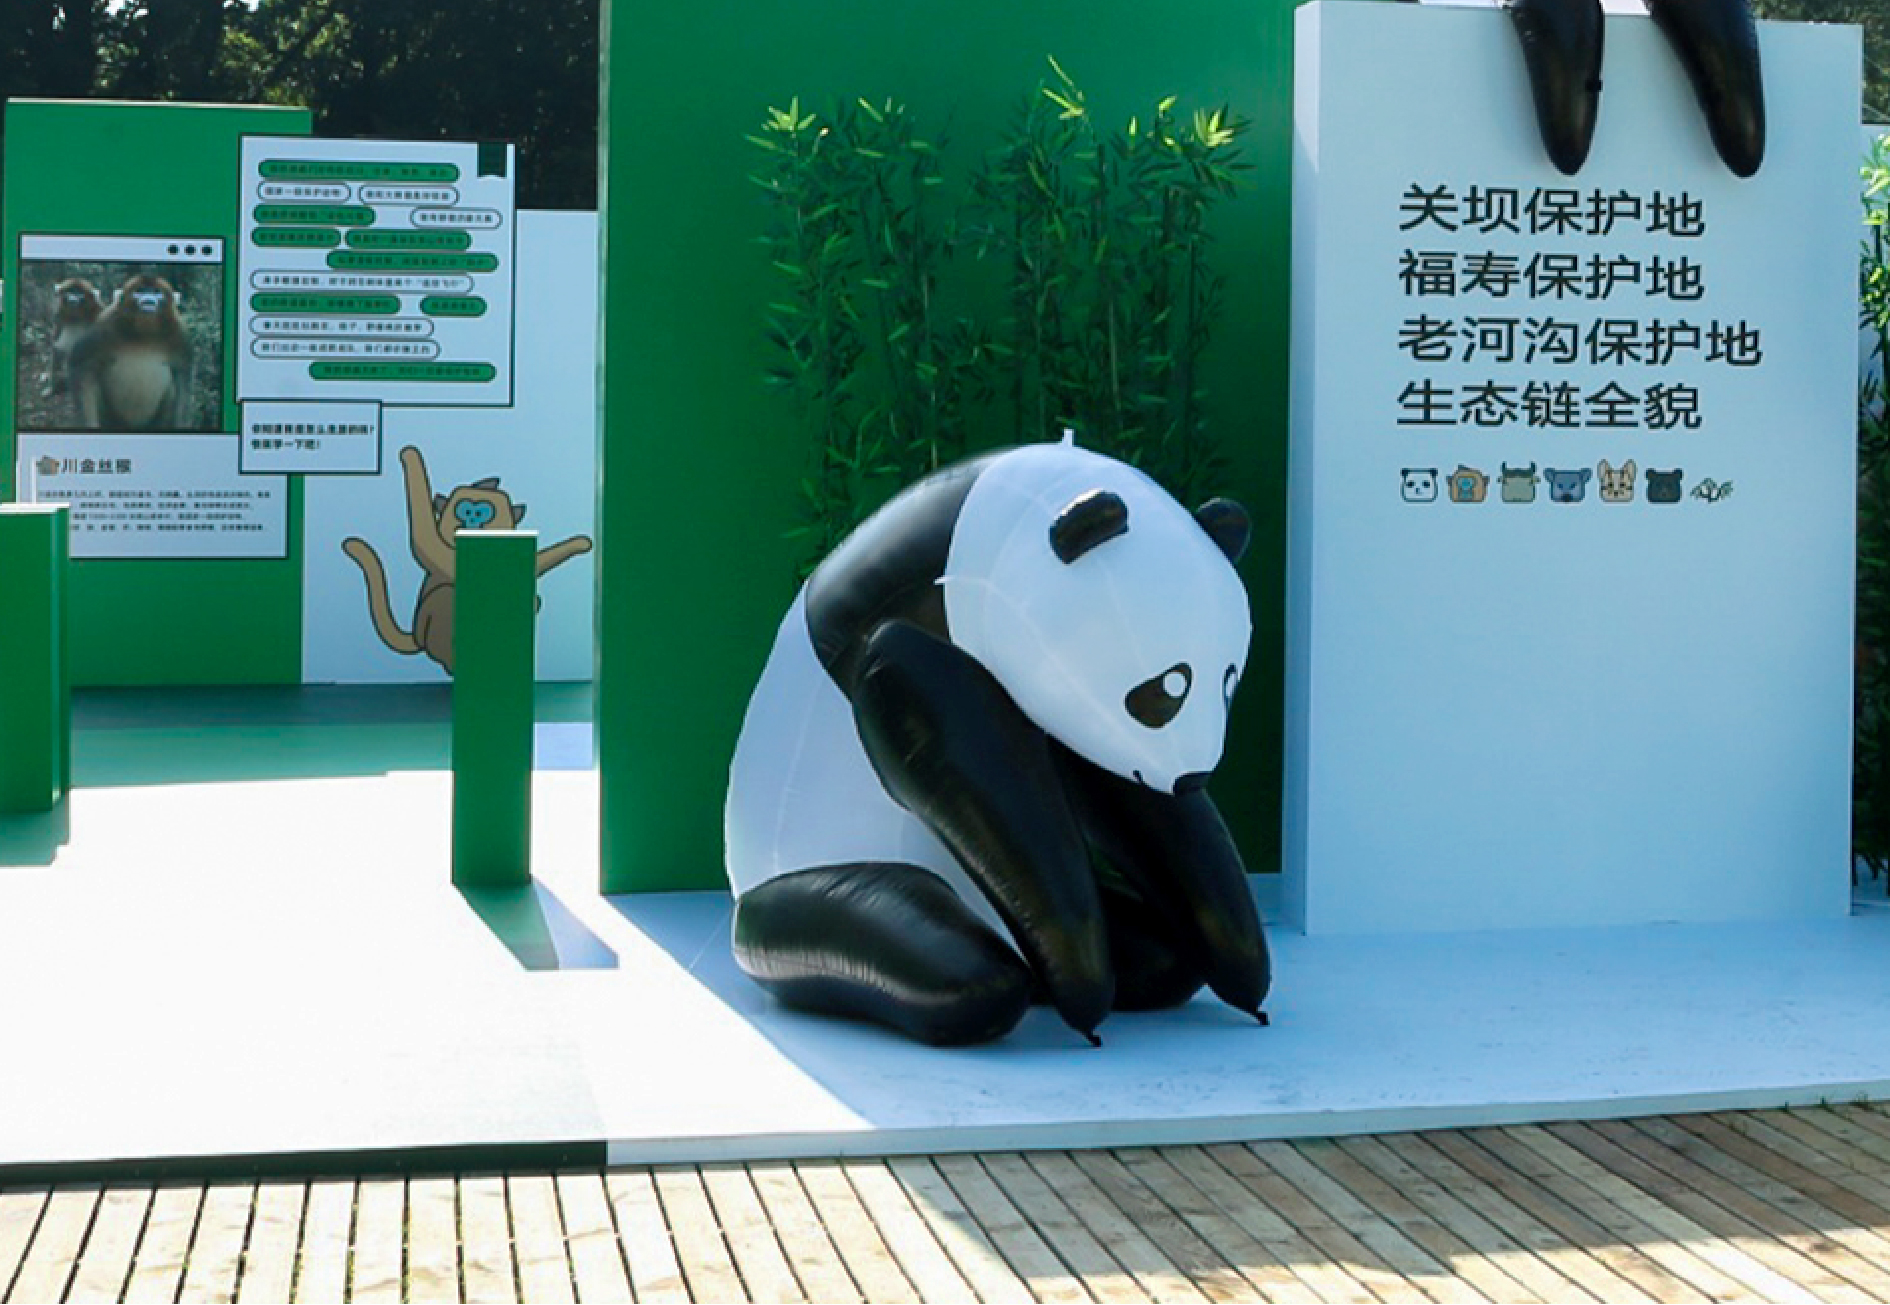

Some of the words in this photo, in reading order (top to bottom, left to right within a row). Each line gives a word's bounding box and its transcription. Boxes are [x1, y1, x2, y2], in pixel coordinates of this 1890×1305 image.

[1398, 182, 1706, 237] 关坝保护地
[1398, 248, 1706, 301] 福寿保护地
[1397, 313, 1764, 367] 老河沟保护地
[1396, 378, 1703, 430] 生态链全貌
